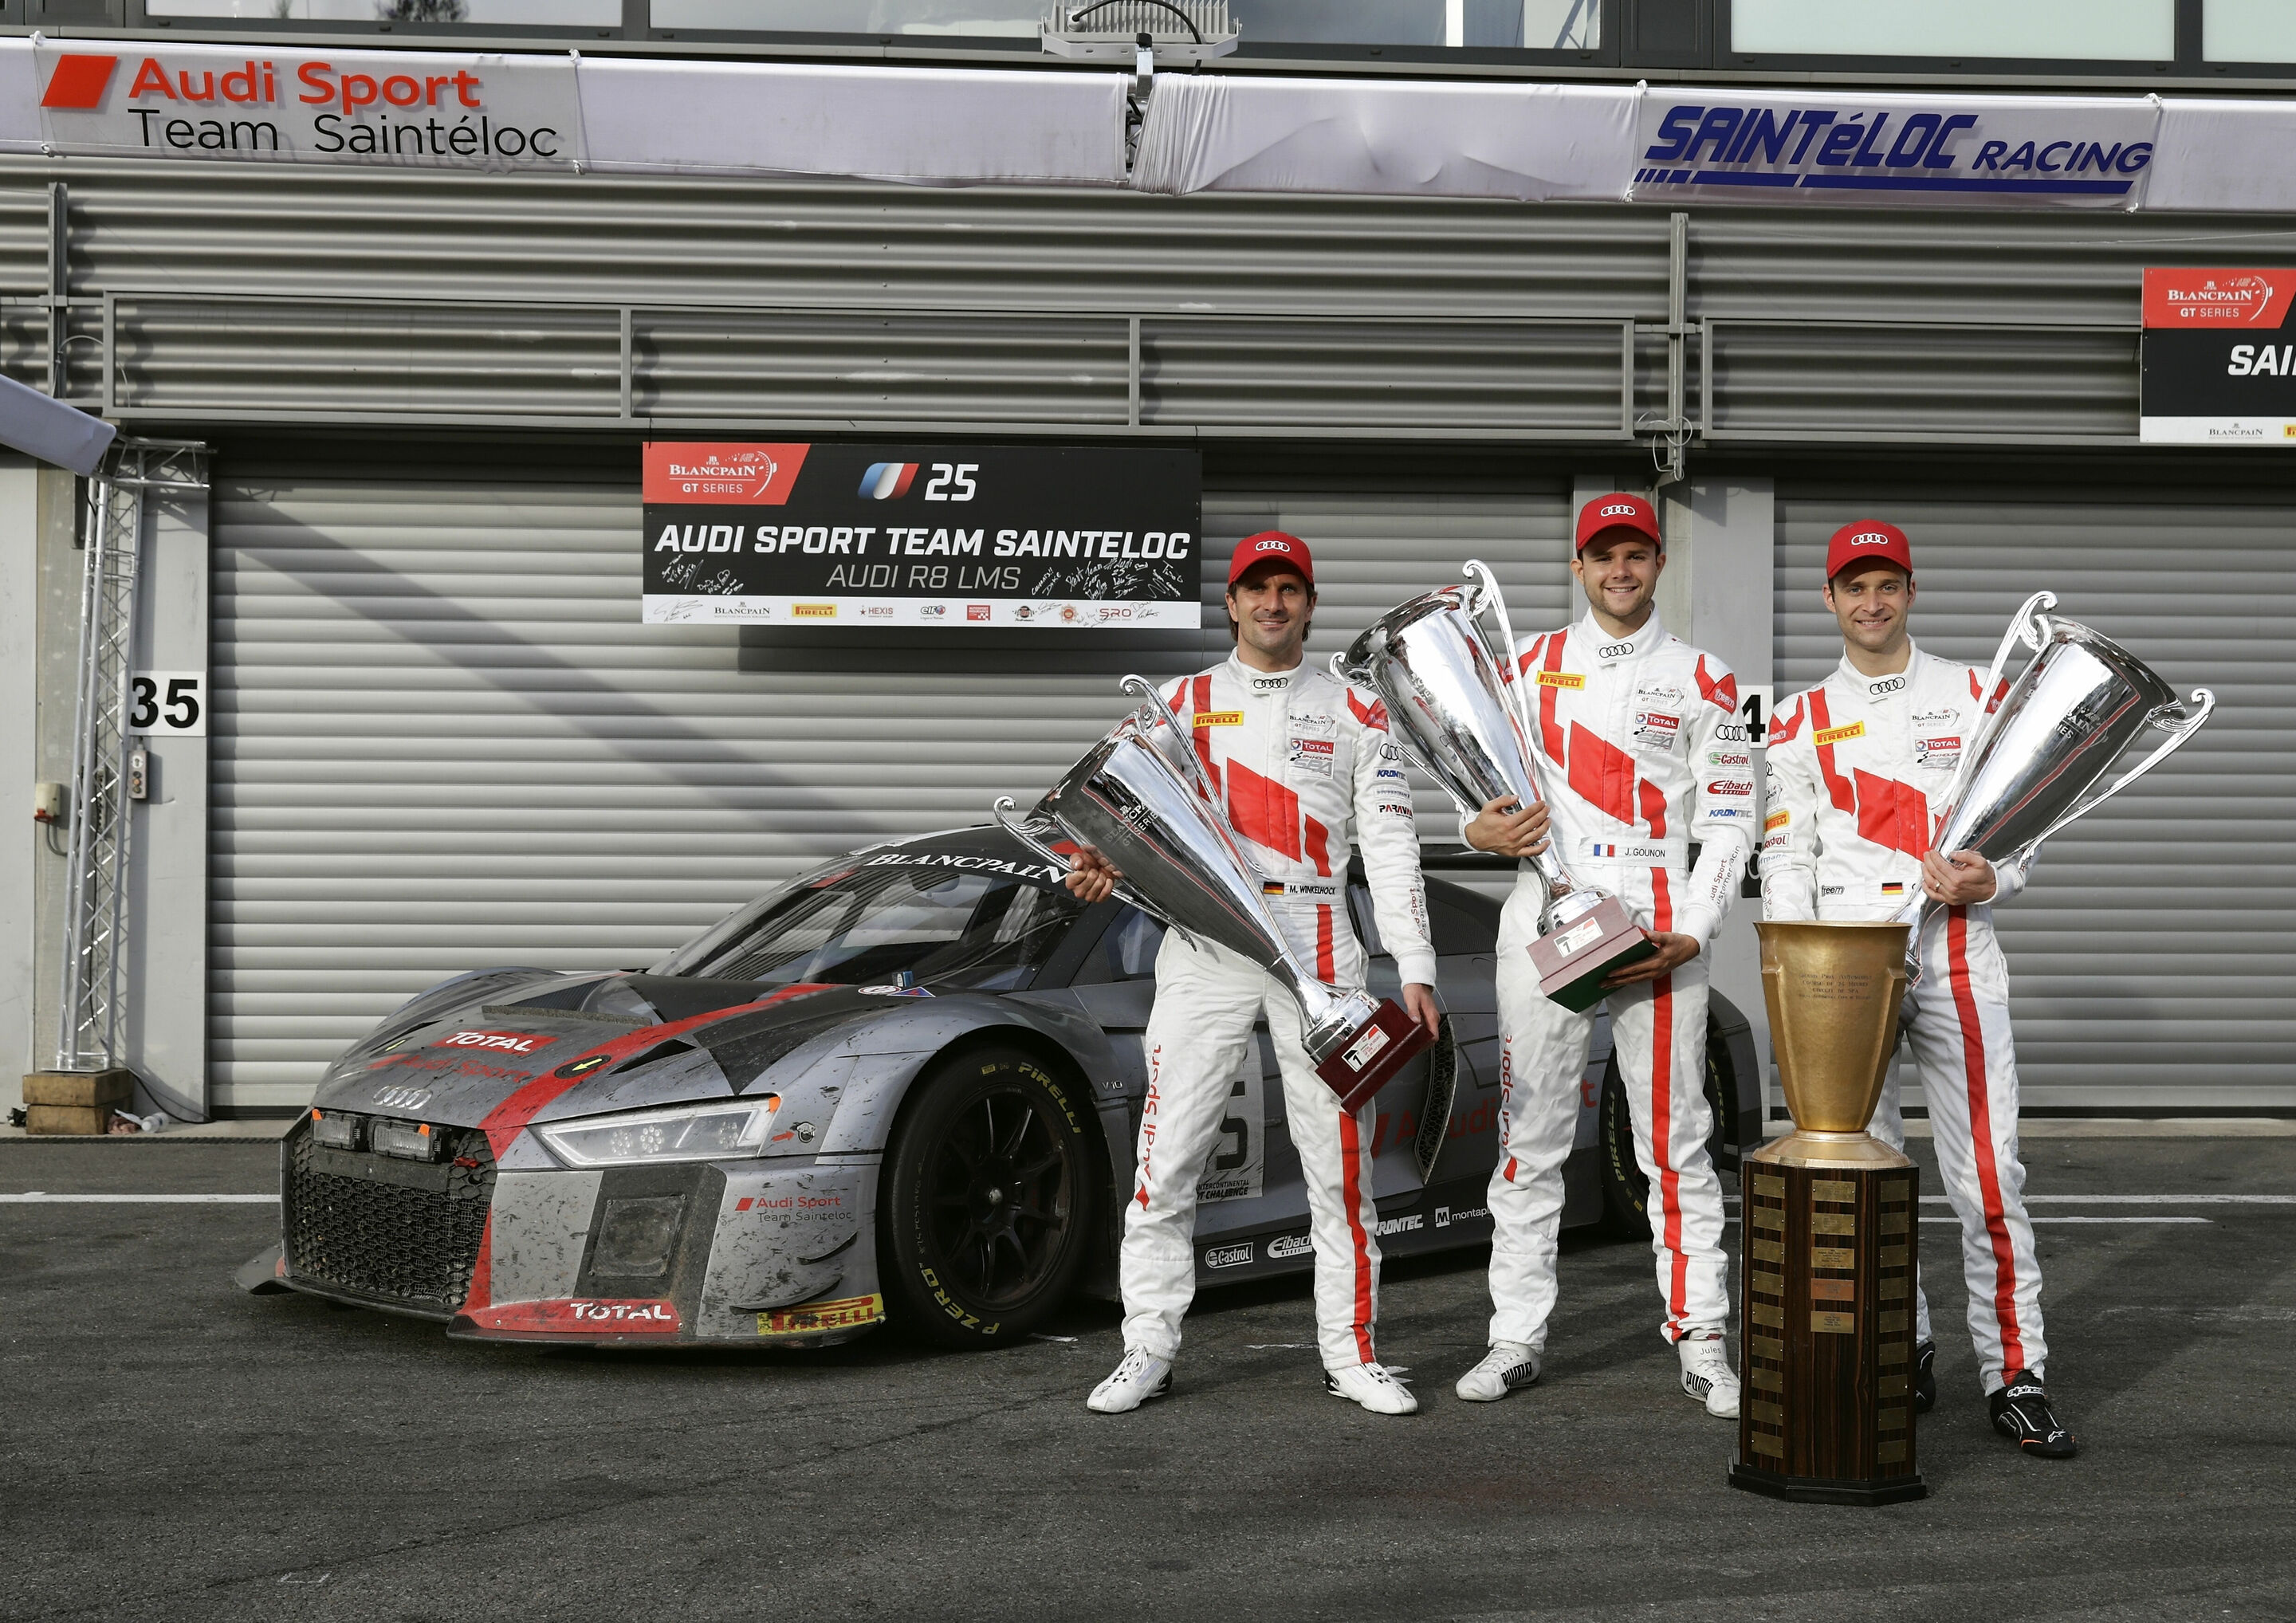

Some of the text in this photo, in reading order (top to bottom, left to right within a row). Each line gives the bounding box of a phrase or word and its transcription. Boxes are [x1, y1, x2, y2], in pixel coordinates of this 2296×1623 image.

[128, 58, 480, 115] Audi Sport
[128, 108, 557, 156] Team Saintéloc
[1972, 140, 2153, 172] RACING
[2168, 289, 2252, 301] BLANCPAIN
[2180, 308, 2239, 317] GT SERIES
[2227, 344, 2296, 375] SAI
[670, 465, 756, 476] BLANCPAIN
[682, 483, 743, 493] GT SERIES
[925, 463, 979, 501] 25
[654, 525, 1190, 559] AUDI SPORT TEAM SAINTELOC
[826, 564, 1021, 589] AUDI R8 LMS
[920, 605, 937, 615] elf
[1539, 674, 1581, 686] PIRELLI
[130, 677, 199, 729] 35
[1196, 714, 1239, 725] PIRELLI
[1289, 715, 1326, 725] BLANCPAIN
[1649, 715, 1677, 726] TOTAL
[1817, 725, 1861, 743] PIRELLI
[1303, 742, 1332, 751] TOTAL
[1720, 754, 1749, 764] Castrol
[1708, 780, 1753, 796] Eibach
[1709, 808, 1752, 818] KRONTEC
[1625, 847, 1665, 857] J. GOUNON
[864, 854, 1067, 883] BLANCPAIN
[1713, 859, 1728, 883] Sport
[1290, 885, 1336, 894] M. WINKELHOCK
[1716, 868, 1732, 905] ustomer
[446, 1032, 533, 1052] TOTAL
[1018, 1062, 1081, 1134] PIRELLI
[1608, 1090, 1626, 1182] PIRELLI
[757, 1196, 841, 1209] Audi Sport
[757, 1212, 791, 1223] Team
[1452, 1207, 1491, 1220] montapl
[1218, 1246, 1249, 1264] Castrol
[921, 1268, 980, 1330] ZERO
[570, 1302, 672, 1320] TOTAL
[771, 1296, 875, 1332] PIRELLI
[1700, 1346, 1722, 1355] Jules
[1501, 1361, 1532, 1385] PUMA
[1686, 1370, 1714, 1401] PUMA
